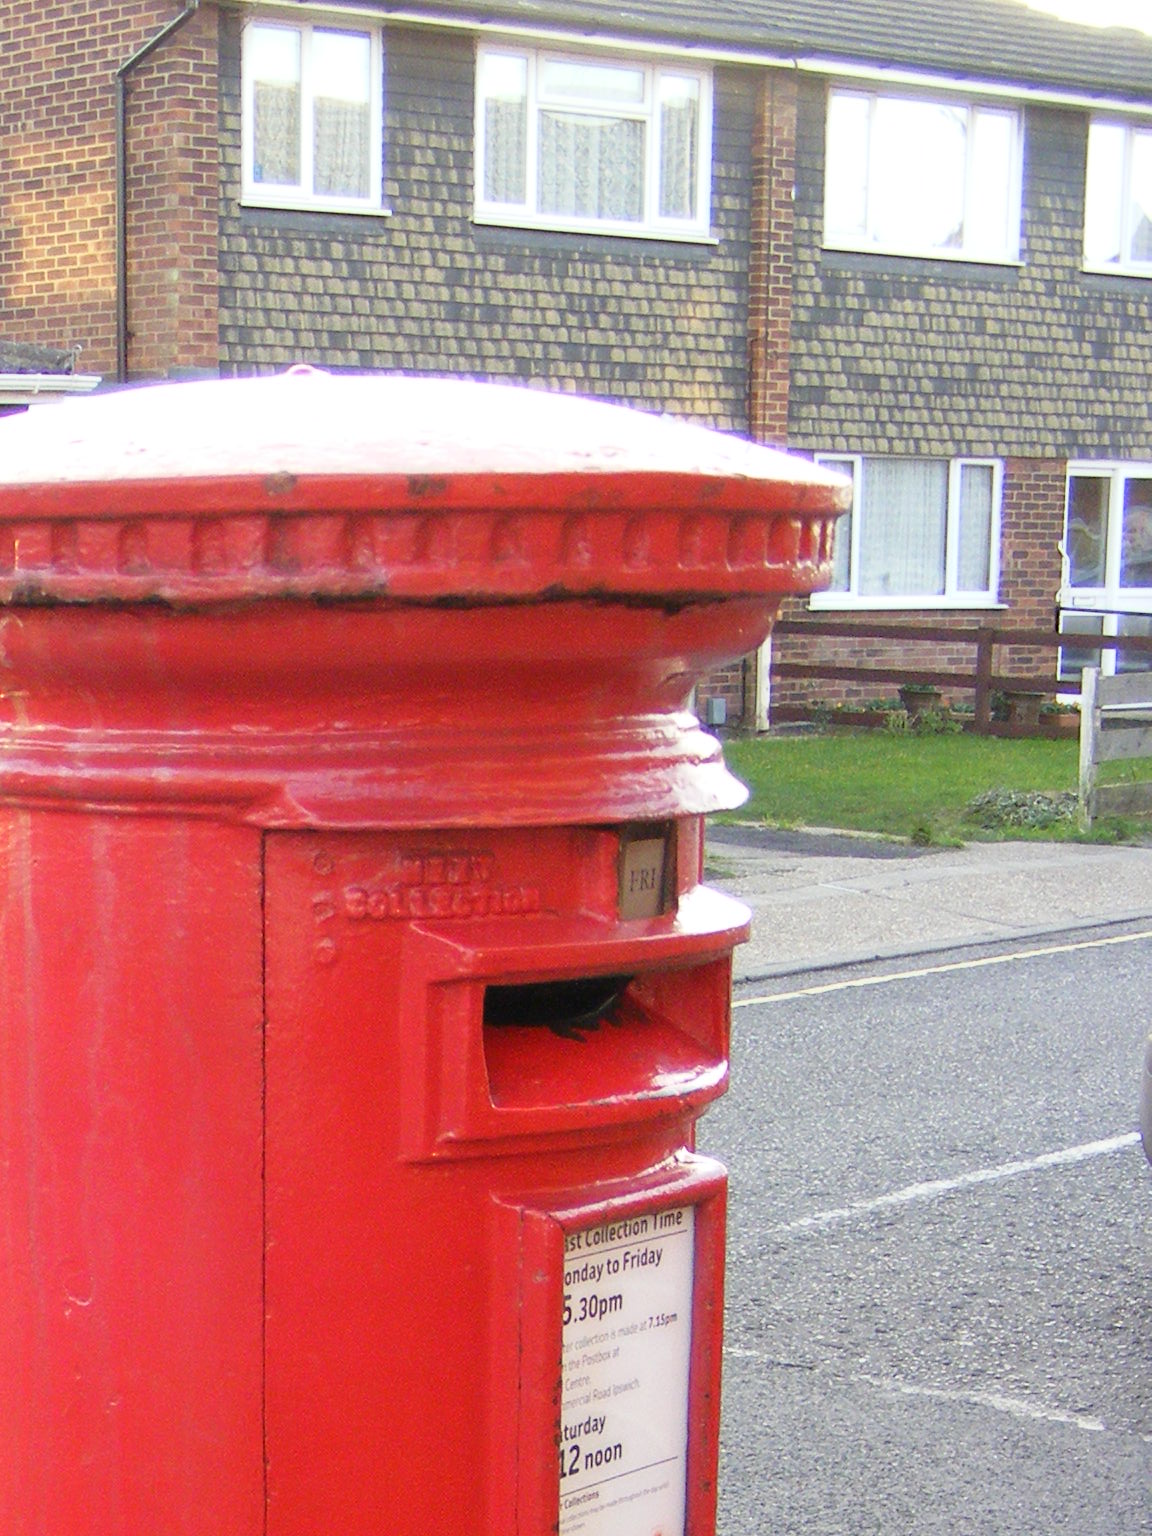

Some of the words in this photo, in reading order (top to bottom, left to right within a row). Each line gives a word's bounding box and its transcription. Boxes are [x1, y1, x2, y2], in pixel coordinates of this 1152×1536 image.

[629, 868, 656, 891] FRI
[564, 1232, 582, 1252] ast
[585, 1219, 648, 1247] Collection
[653, 1211, 683, 1231] Time
[564, 1262, 604, 1286] onday
[607, 1258, 620, 1275] to
[623, 1247, 663, 1271] Friday
[562, 1294, 623, 1326] 5.30pm
[561, 1416, 606, 1442] turday
[560, 1444, 580, 1478] 12
[584, 1442, 623, 1470] noon
